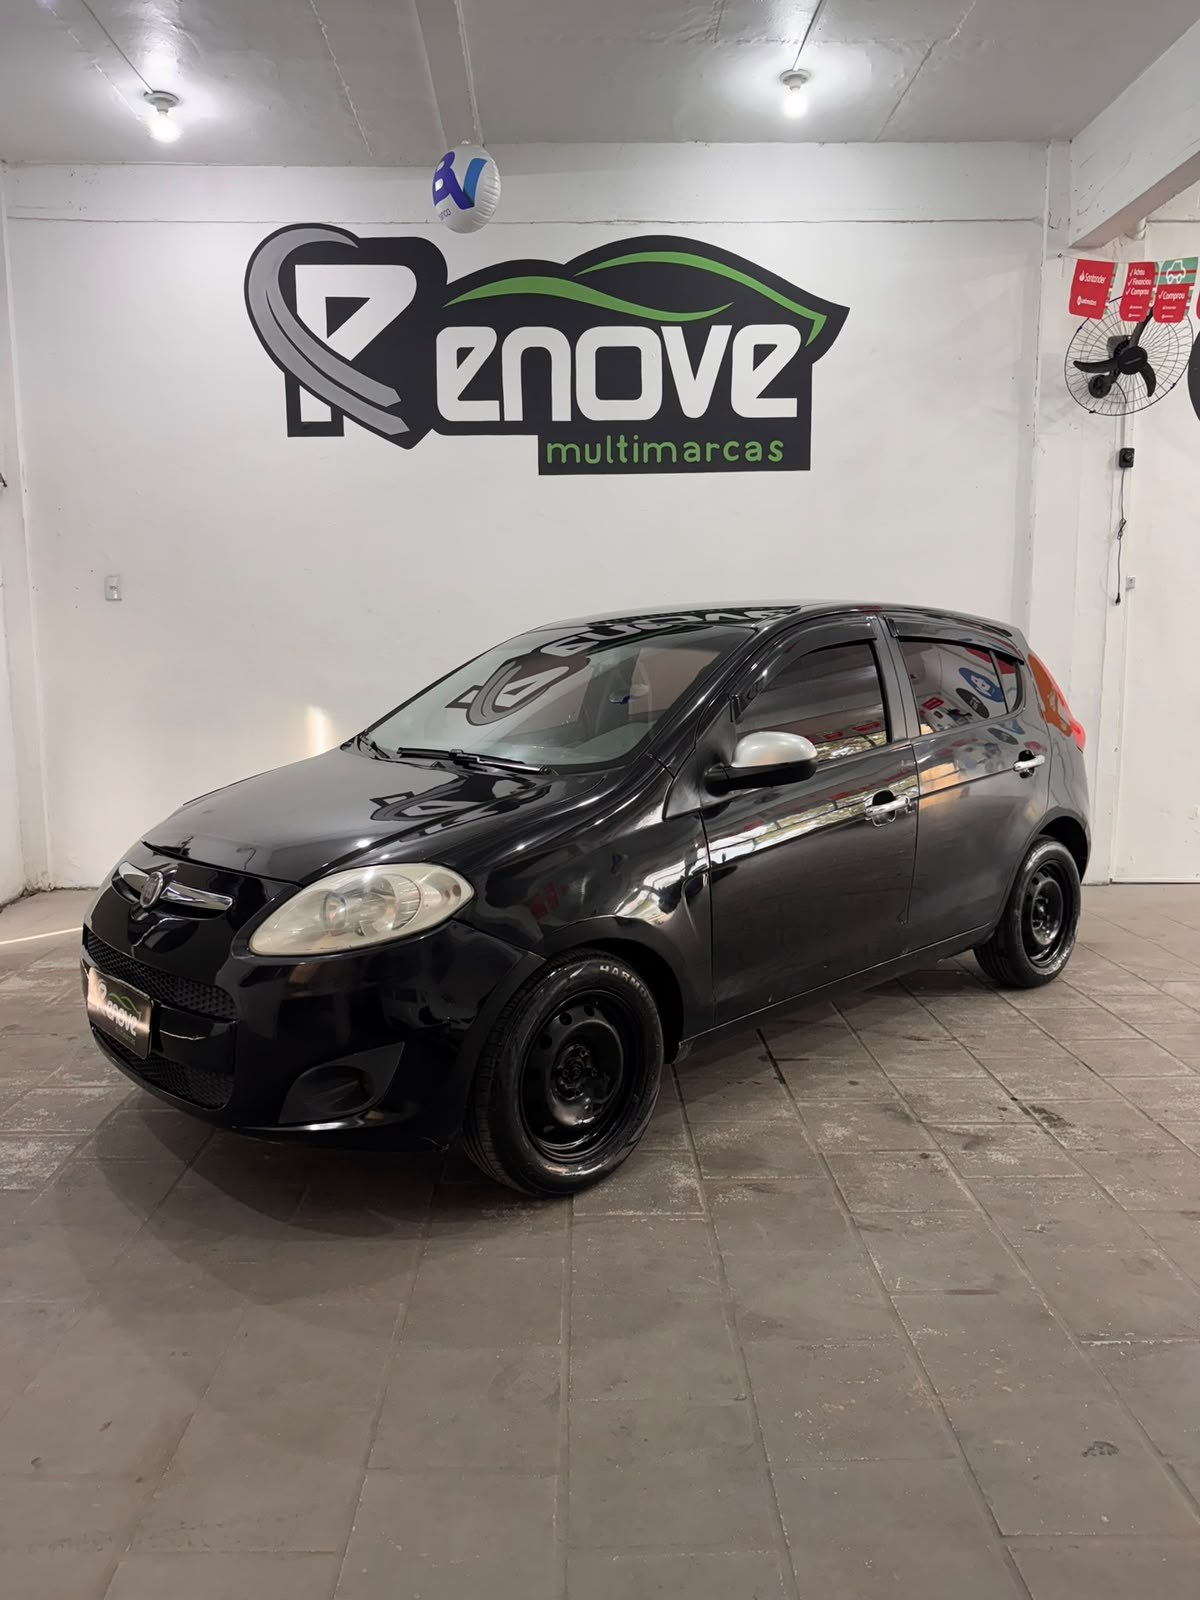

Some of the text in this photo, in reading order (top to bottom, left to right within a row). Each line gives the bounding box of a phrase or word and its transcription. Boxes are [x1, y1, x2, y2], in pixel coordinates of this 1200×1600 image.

[1084, 272, 1106, 284] Santander
[1162, 291, 1186, 302] Comprou
[547, 434, 784, 466] multimarcas
